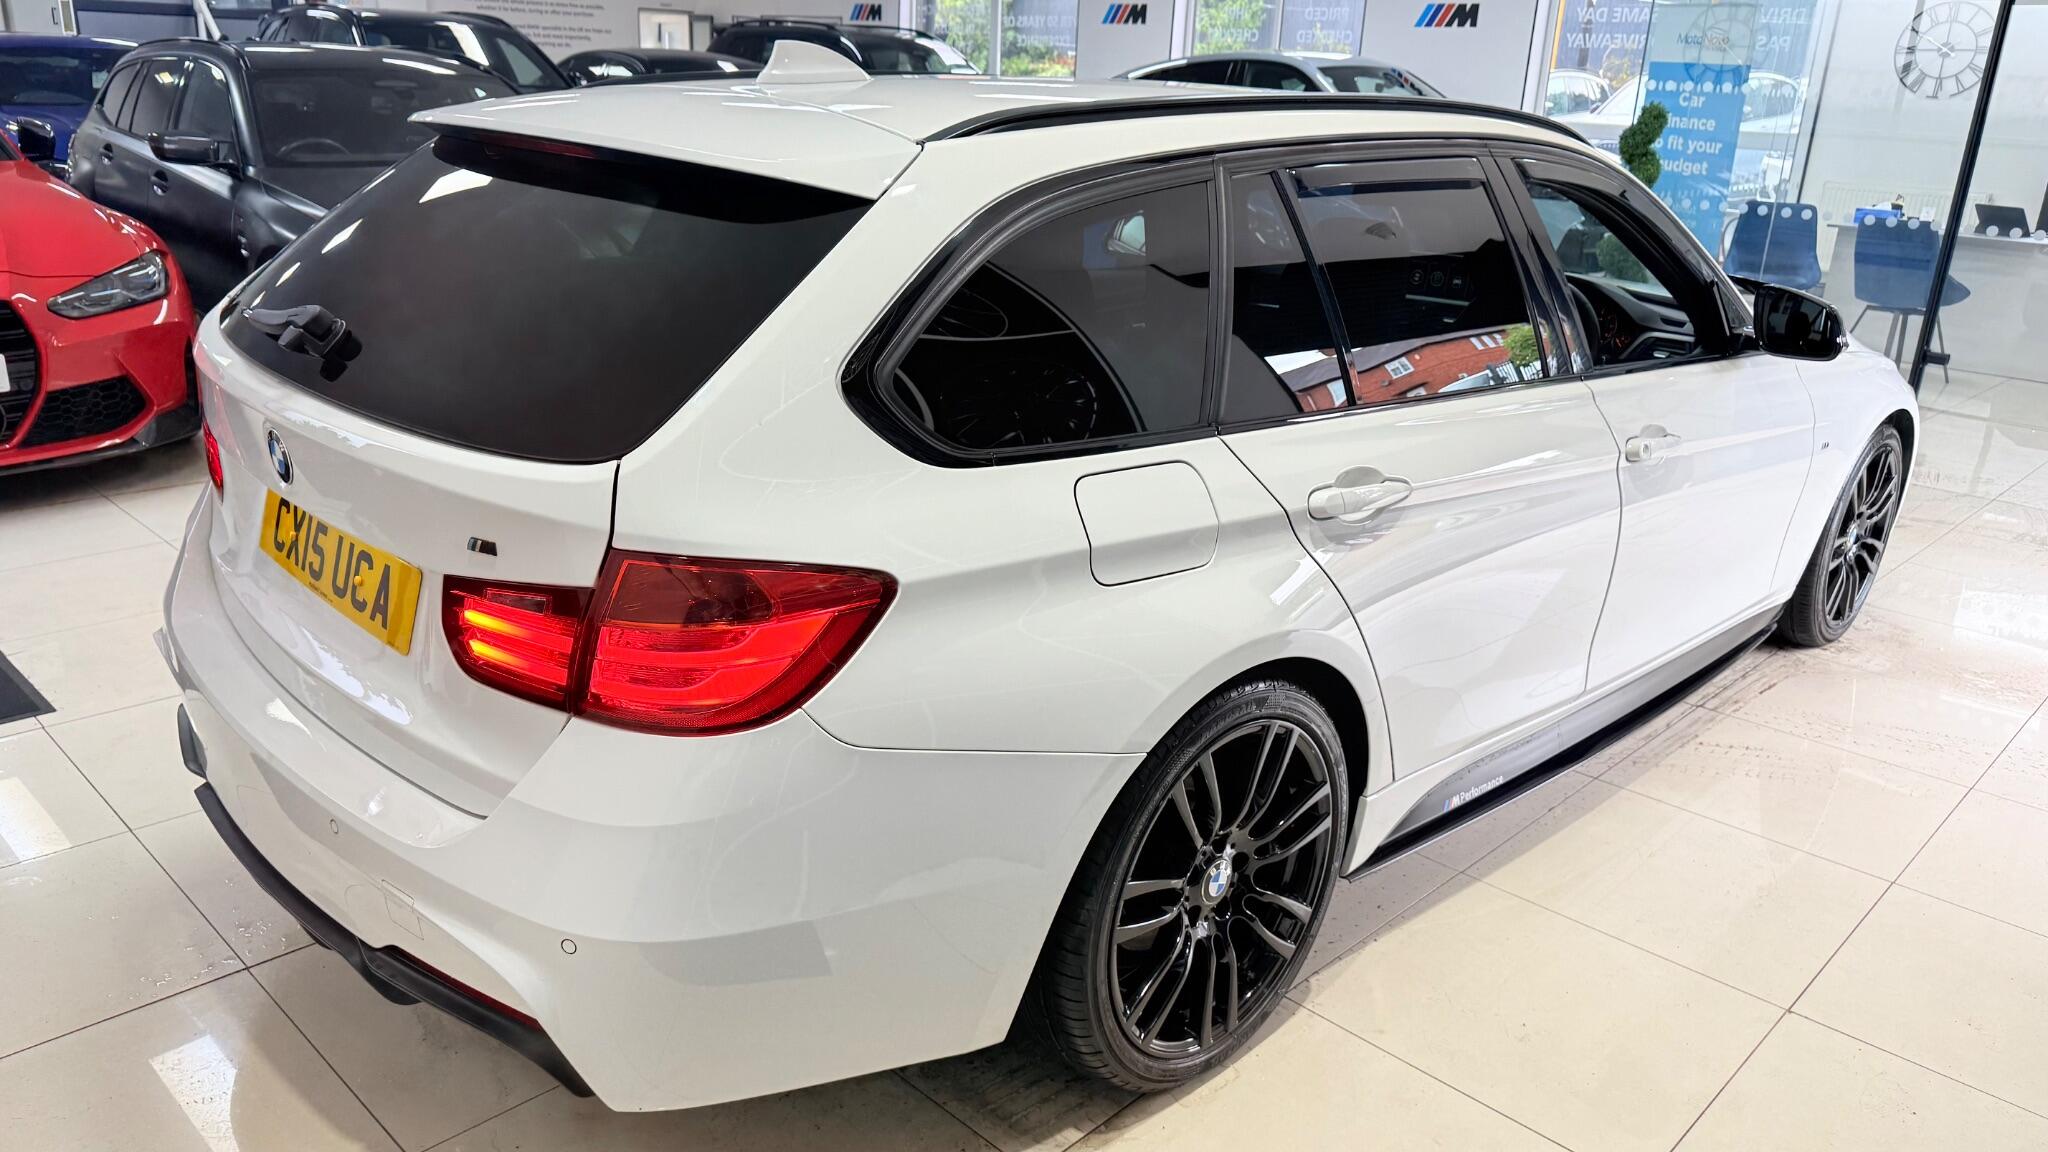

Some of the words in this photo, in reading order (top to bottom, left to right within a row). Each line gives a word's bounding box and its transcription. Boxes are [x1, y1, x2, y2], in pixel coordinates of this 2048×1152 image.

[1679, 92, 1706, 108] Car
[1667, 112, 1716, 131] inance
[1667, 134, 1684, 150] fit
[1686, 139, 1723, 155] your
[273, 497, 328, 583] CX15
[332, 534, 391, 630] UCA
[1460, 775, 1504, 804] Performance
